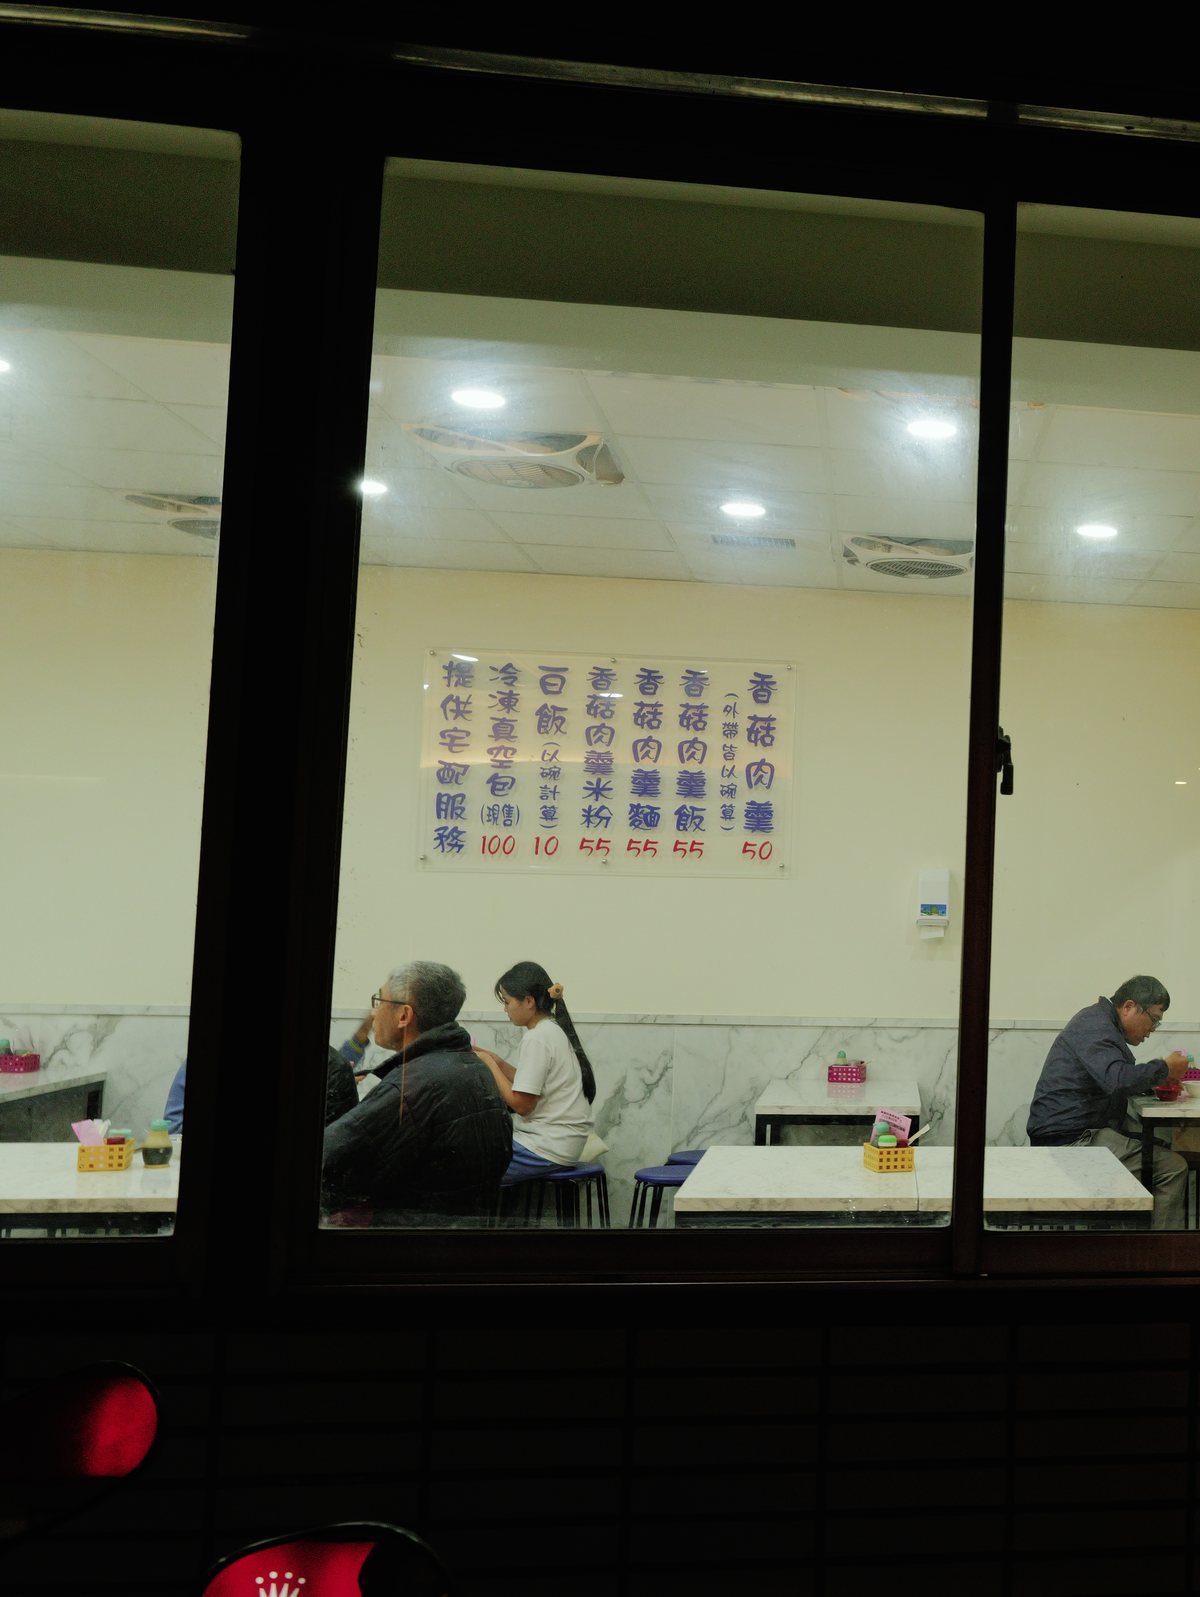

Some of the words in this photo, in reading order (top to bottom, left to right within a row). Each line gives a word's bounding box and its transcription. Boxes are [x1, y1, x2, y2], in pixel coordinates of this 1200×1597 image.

[433, 660, 474, 854] 提供宅配服務
[485, 662, 522, 797] 冷凍真空包
[580, 666, 618, 829] 香菇肉羹米粉
[627, 667, 665, 832] 香菇肉羹麵
[673, 669, 710, 833] 香菇肉羹飯
[743, 671, 778, 834] 香菇肉羹
[481, 834, 515, 855] 100
[534, 835, 559, 856] 10
[579, 837, 612, 857] 55
[626, 838, 659, 859] 55
[672, 839, 705, 859] 55
[741, 840, 773, 861] 50
